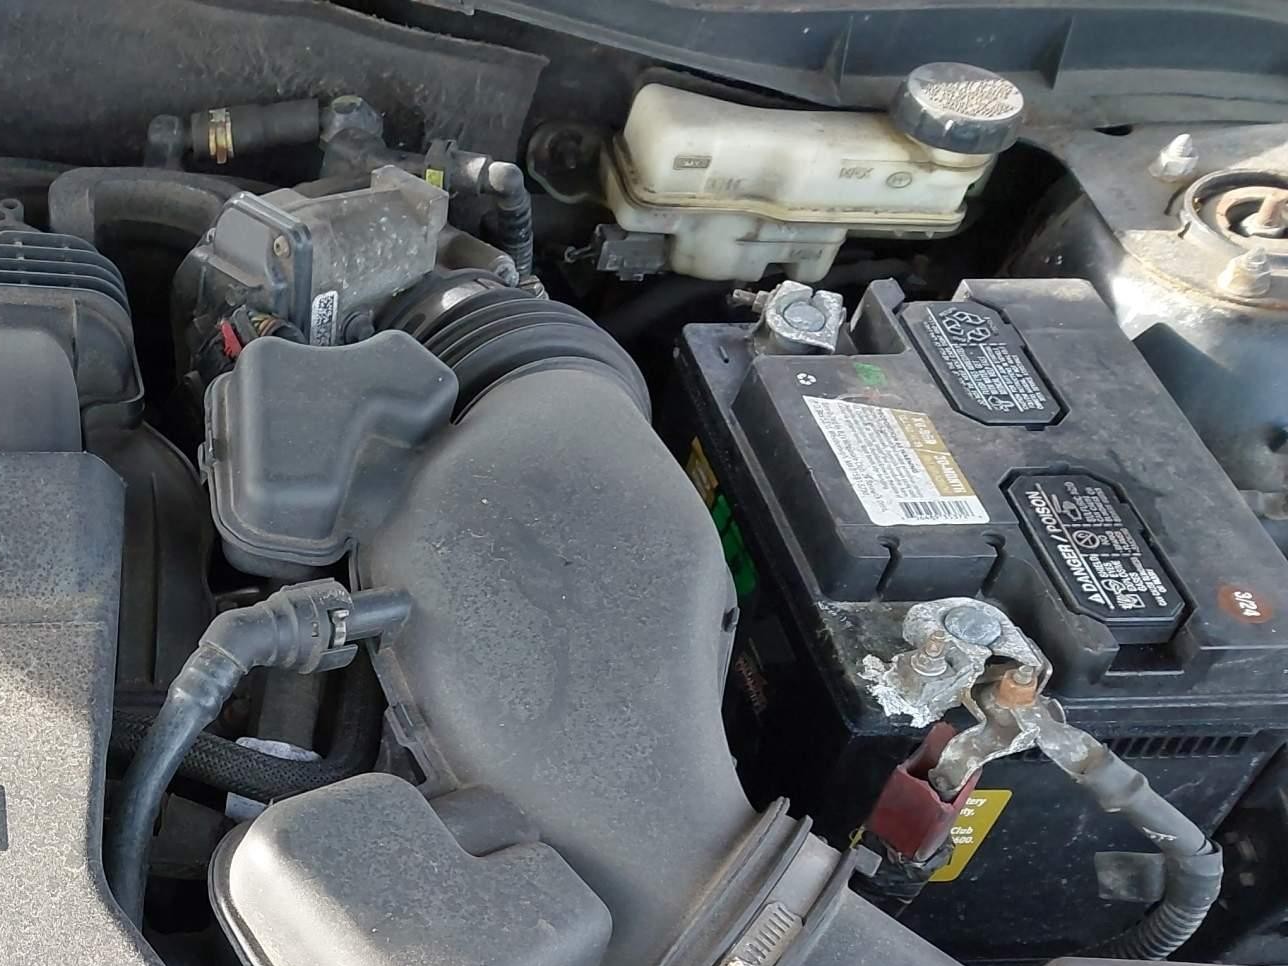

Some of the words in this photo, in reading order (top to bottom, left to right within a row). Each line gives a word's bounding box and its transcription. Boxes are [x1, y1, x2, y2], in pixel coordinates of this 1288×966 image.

[1025, 491, 1063, 533] POISON
[1051, 534, 1068, 543] /
[1057, 544, 1098, 592] DANGER
[950, 826, 974, 835] Club
